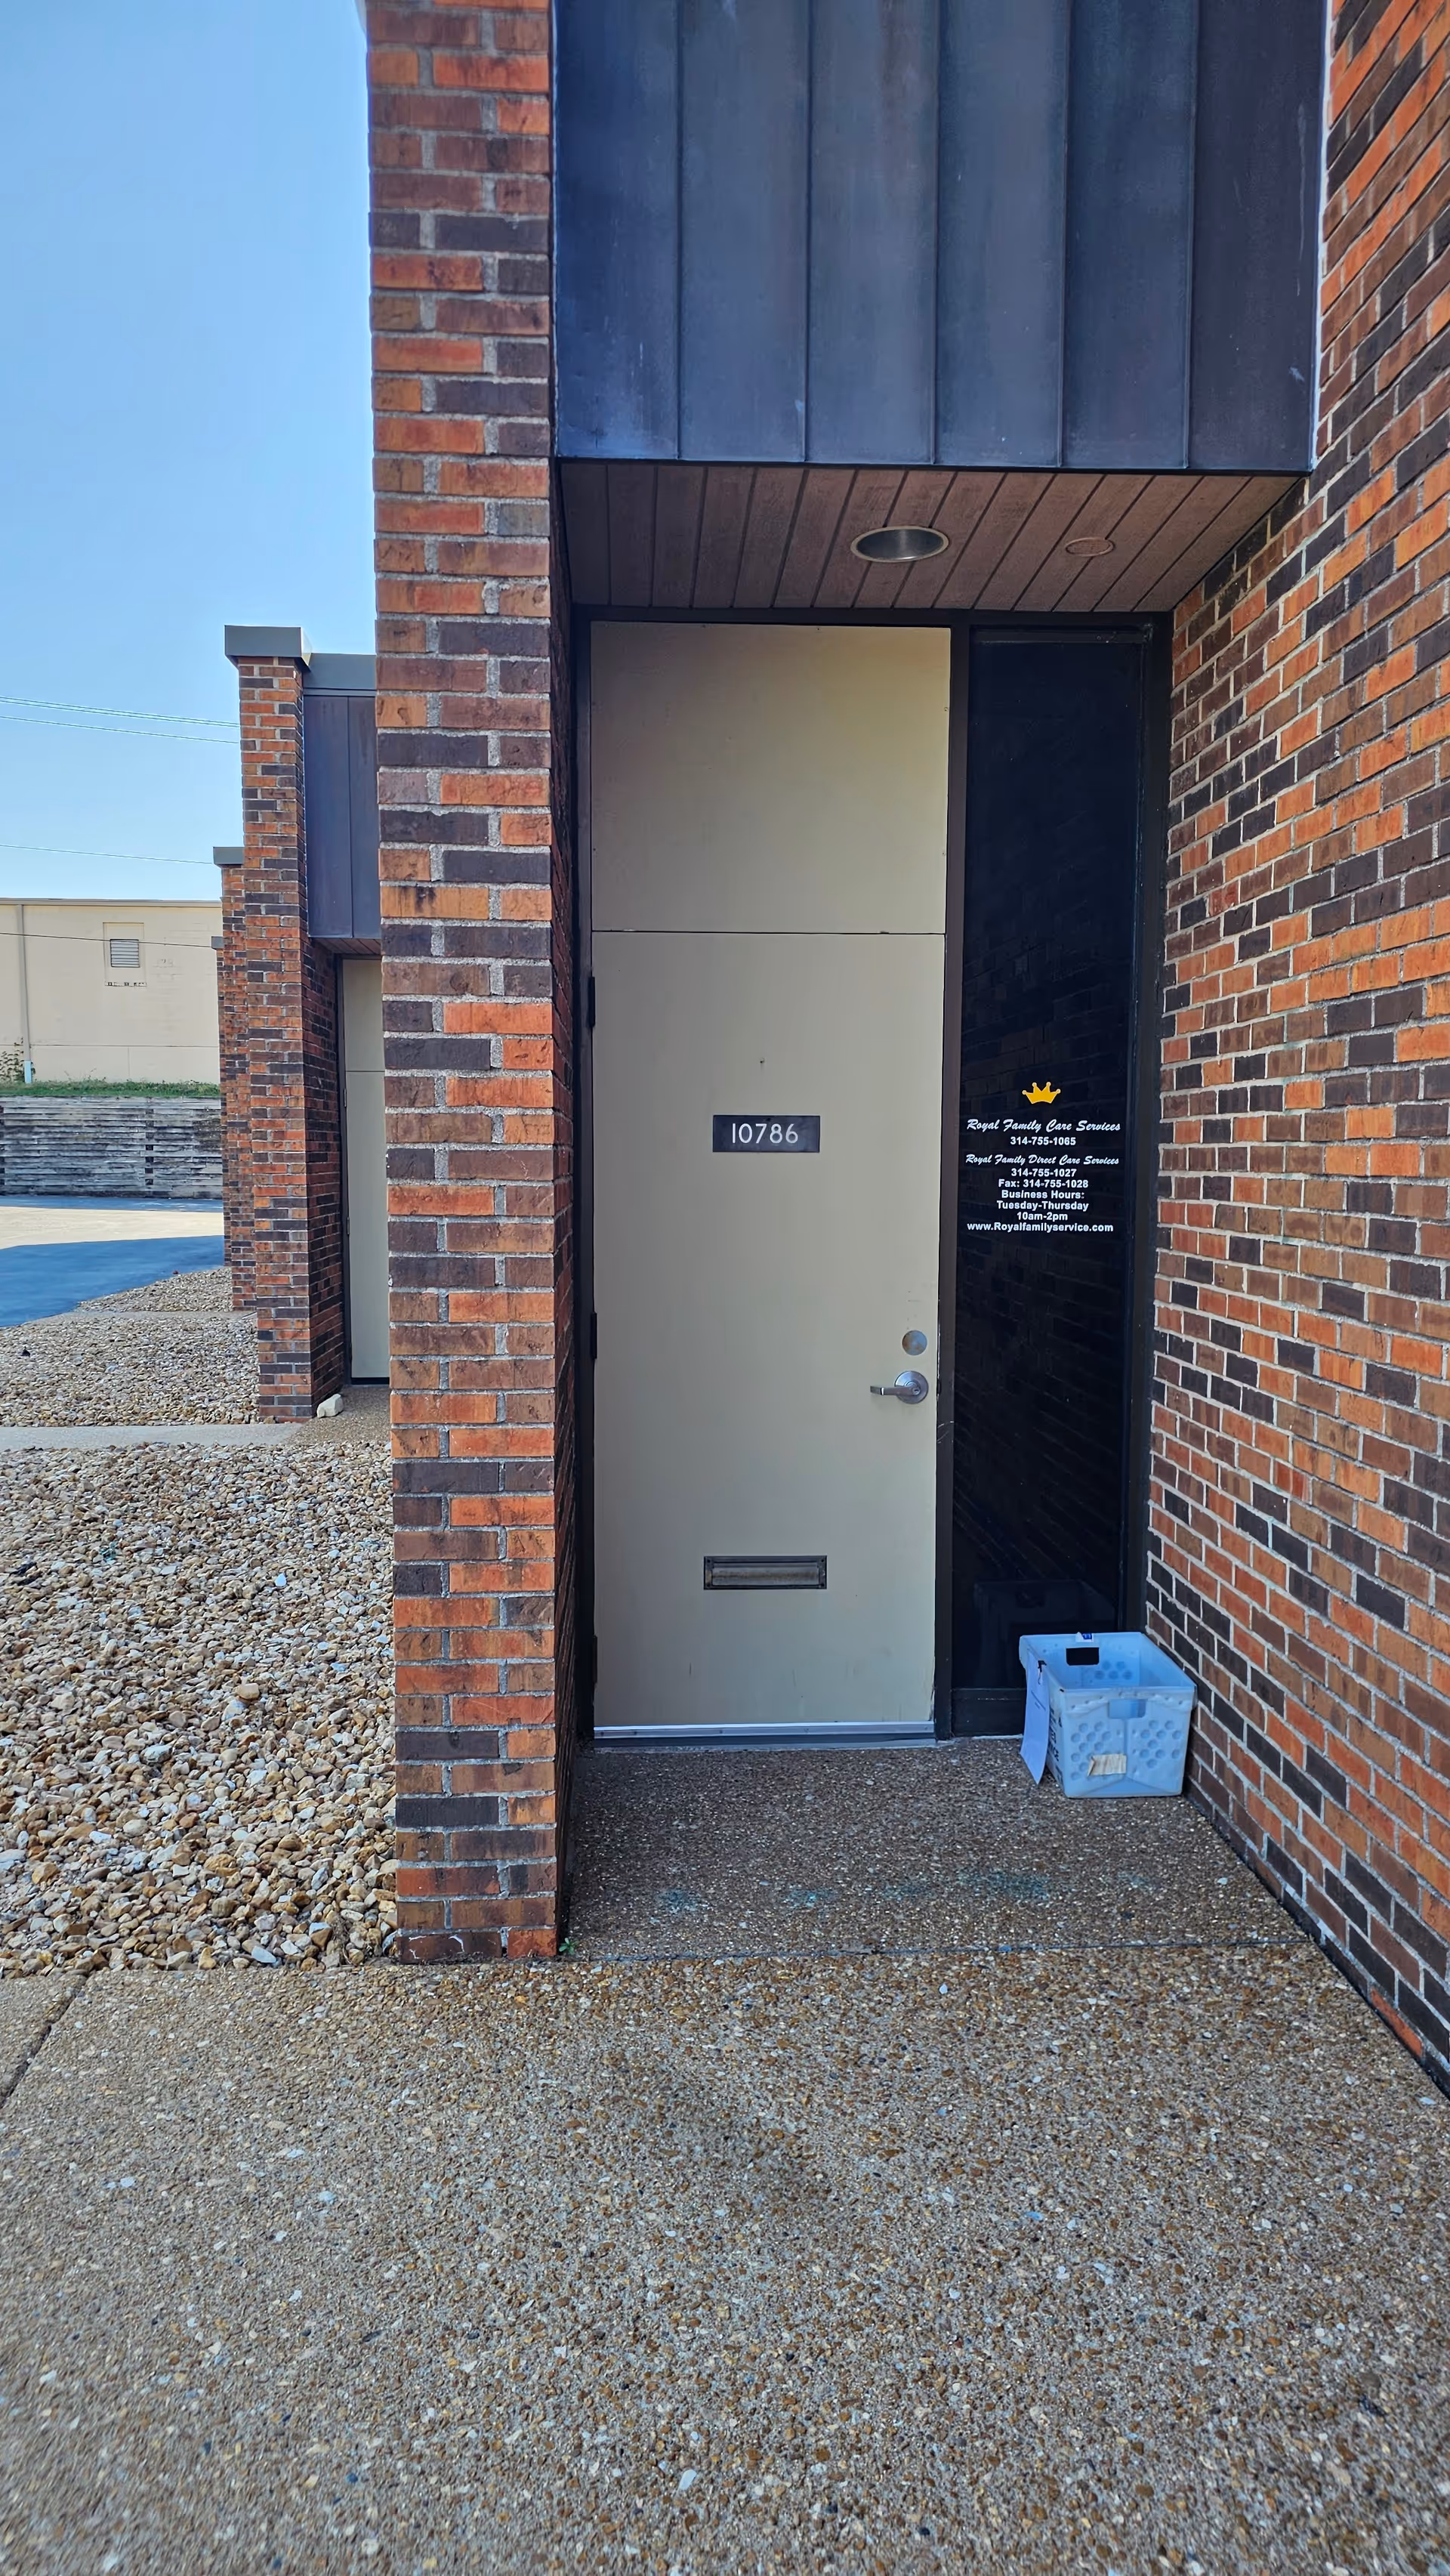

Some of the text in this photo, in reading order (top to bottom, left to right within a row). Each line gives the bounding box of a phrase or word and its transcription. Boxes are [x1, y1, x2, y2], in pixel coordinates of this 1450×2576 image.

[967, 1119, 1121, 1133] Royal Family Care Services
[732, 1123, 798, 1144] 10786
[1010, 1136, 1076, 1146] 314-755-1065
[965, 1154, 1119, 1166] Royal Family Direct Care Services
[1010, 1168, 1077, 1178] 314-755-1027
[998, 1178, 1089, 1188] Fax: 314-755-1028
[1001, 1190, 1084, 1200] Business Hours:
[996, 1200, 1089, 1212] Tuesday-Thursday
[1017, 1212, 1069, 1222] 10am-2pm
[967, 1222, 1114, 1234] www.Royalfamilyservice.com
